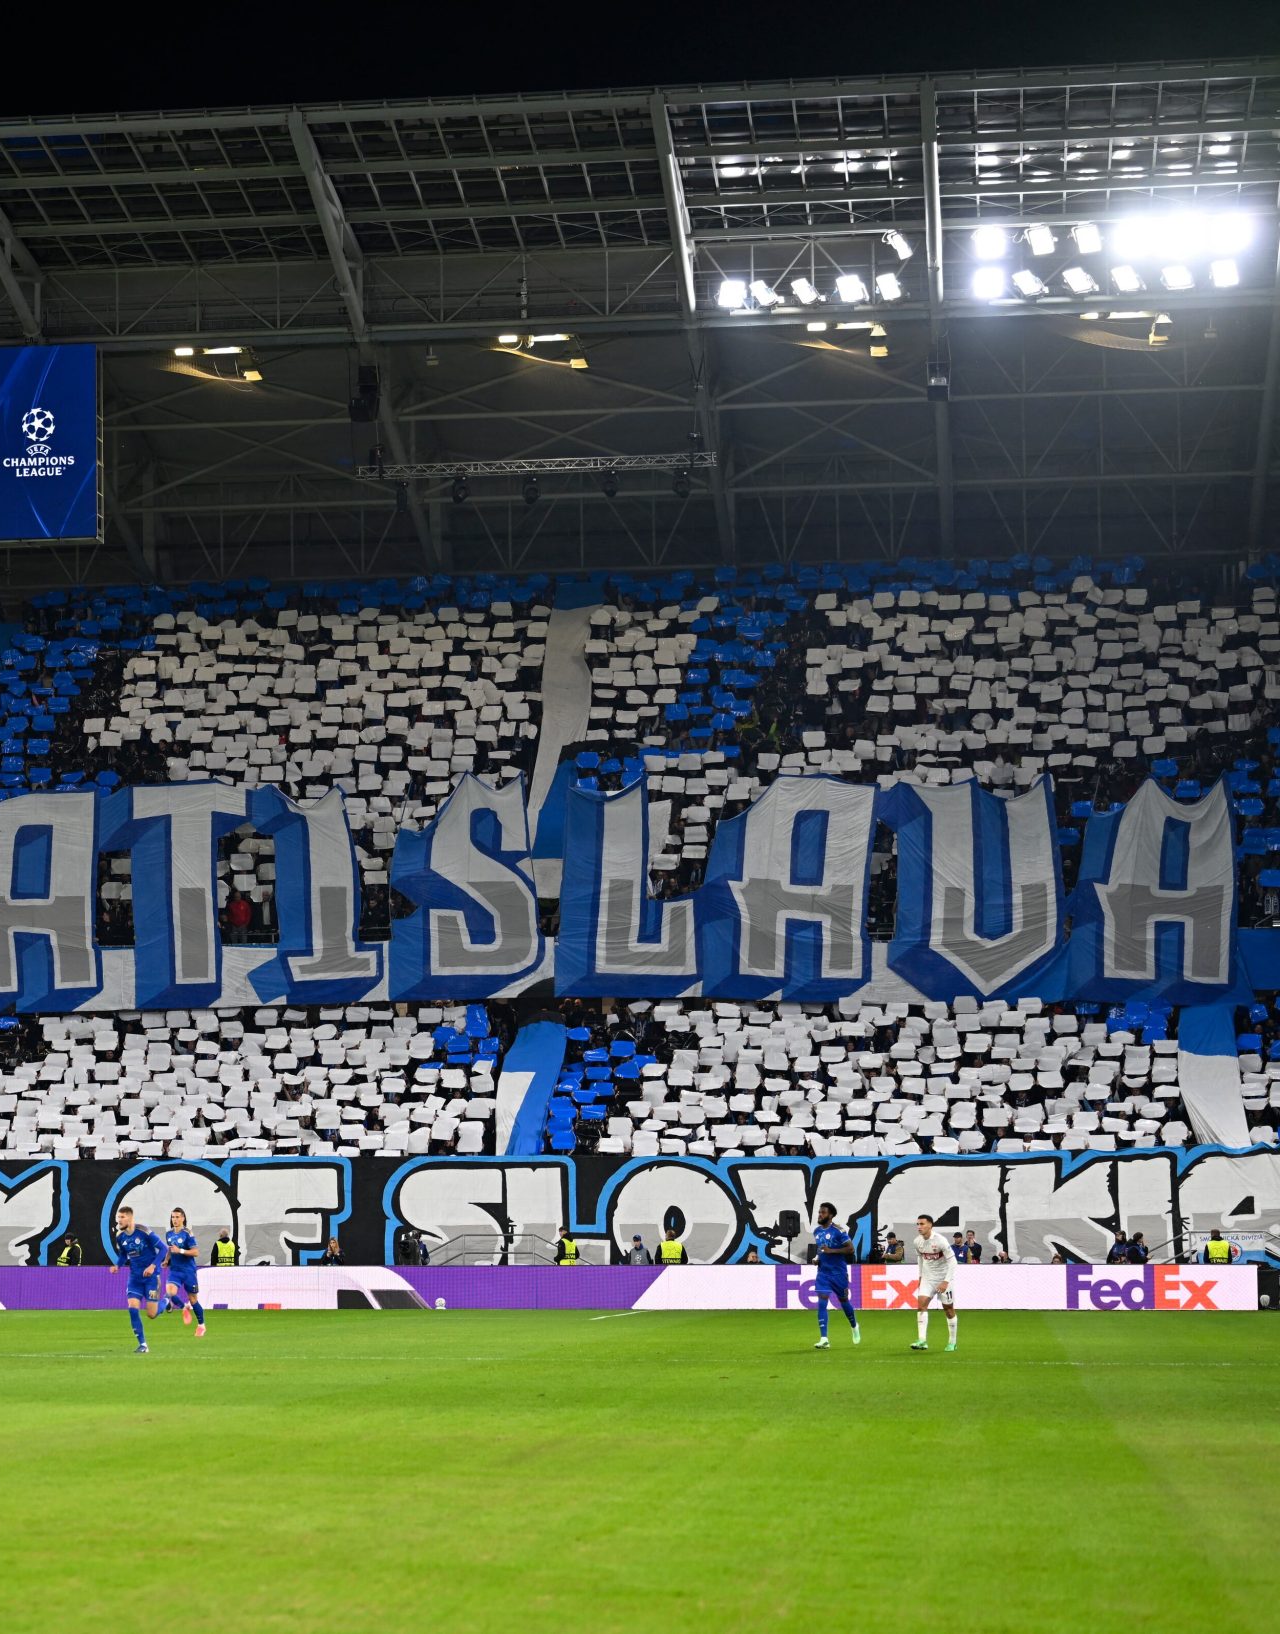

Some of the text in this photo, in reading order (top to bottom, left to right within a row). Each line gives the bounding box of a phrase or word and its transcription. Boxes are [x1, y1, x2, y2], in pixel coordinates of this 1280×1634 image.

[26, 446, 50, 455] UEFA
[2, 455, 76, 468] CHAMPIONS
[15, 466, 63, 477] LEAGUE
[113, 1166, 340, 1266] OF
[396, 1153, 1280, 1265] SLOVAKIA
[1066, 1264, 1219, 1310] FedEx
[946, 1290, 953, 1300] 11
